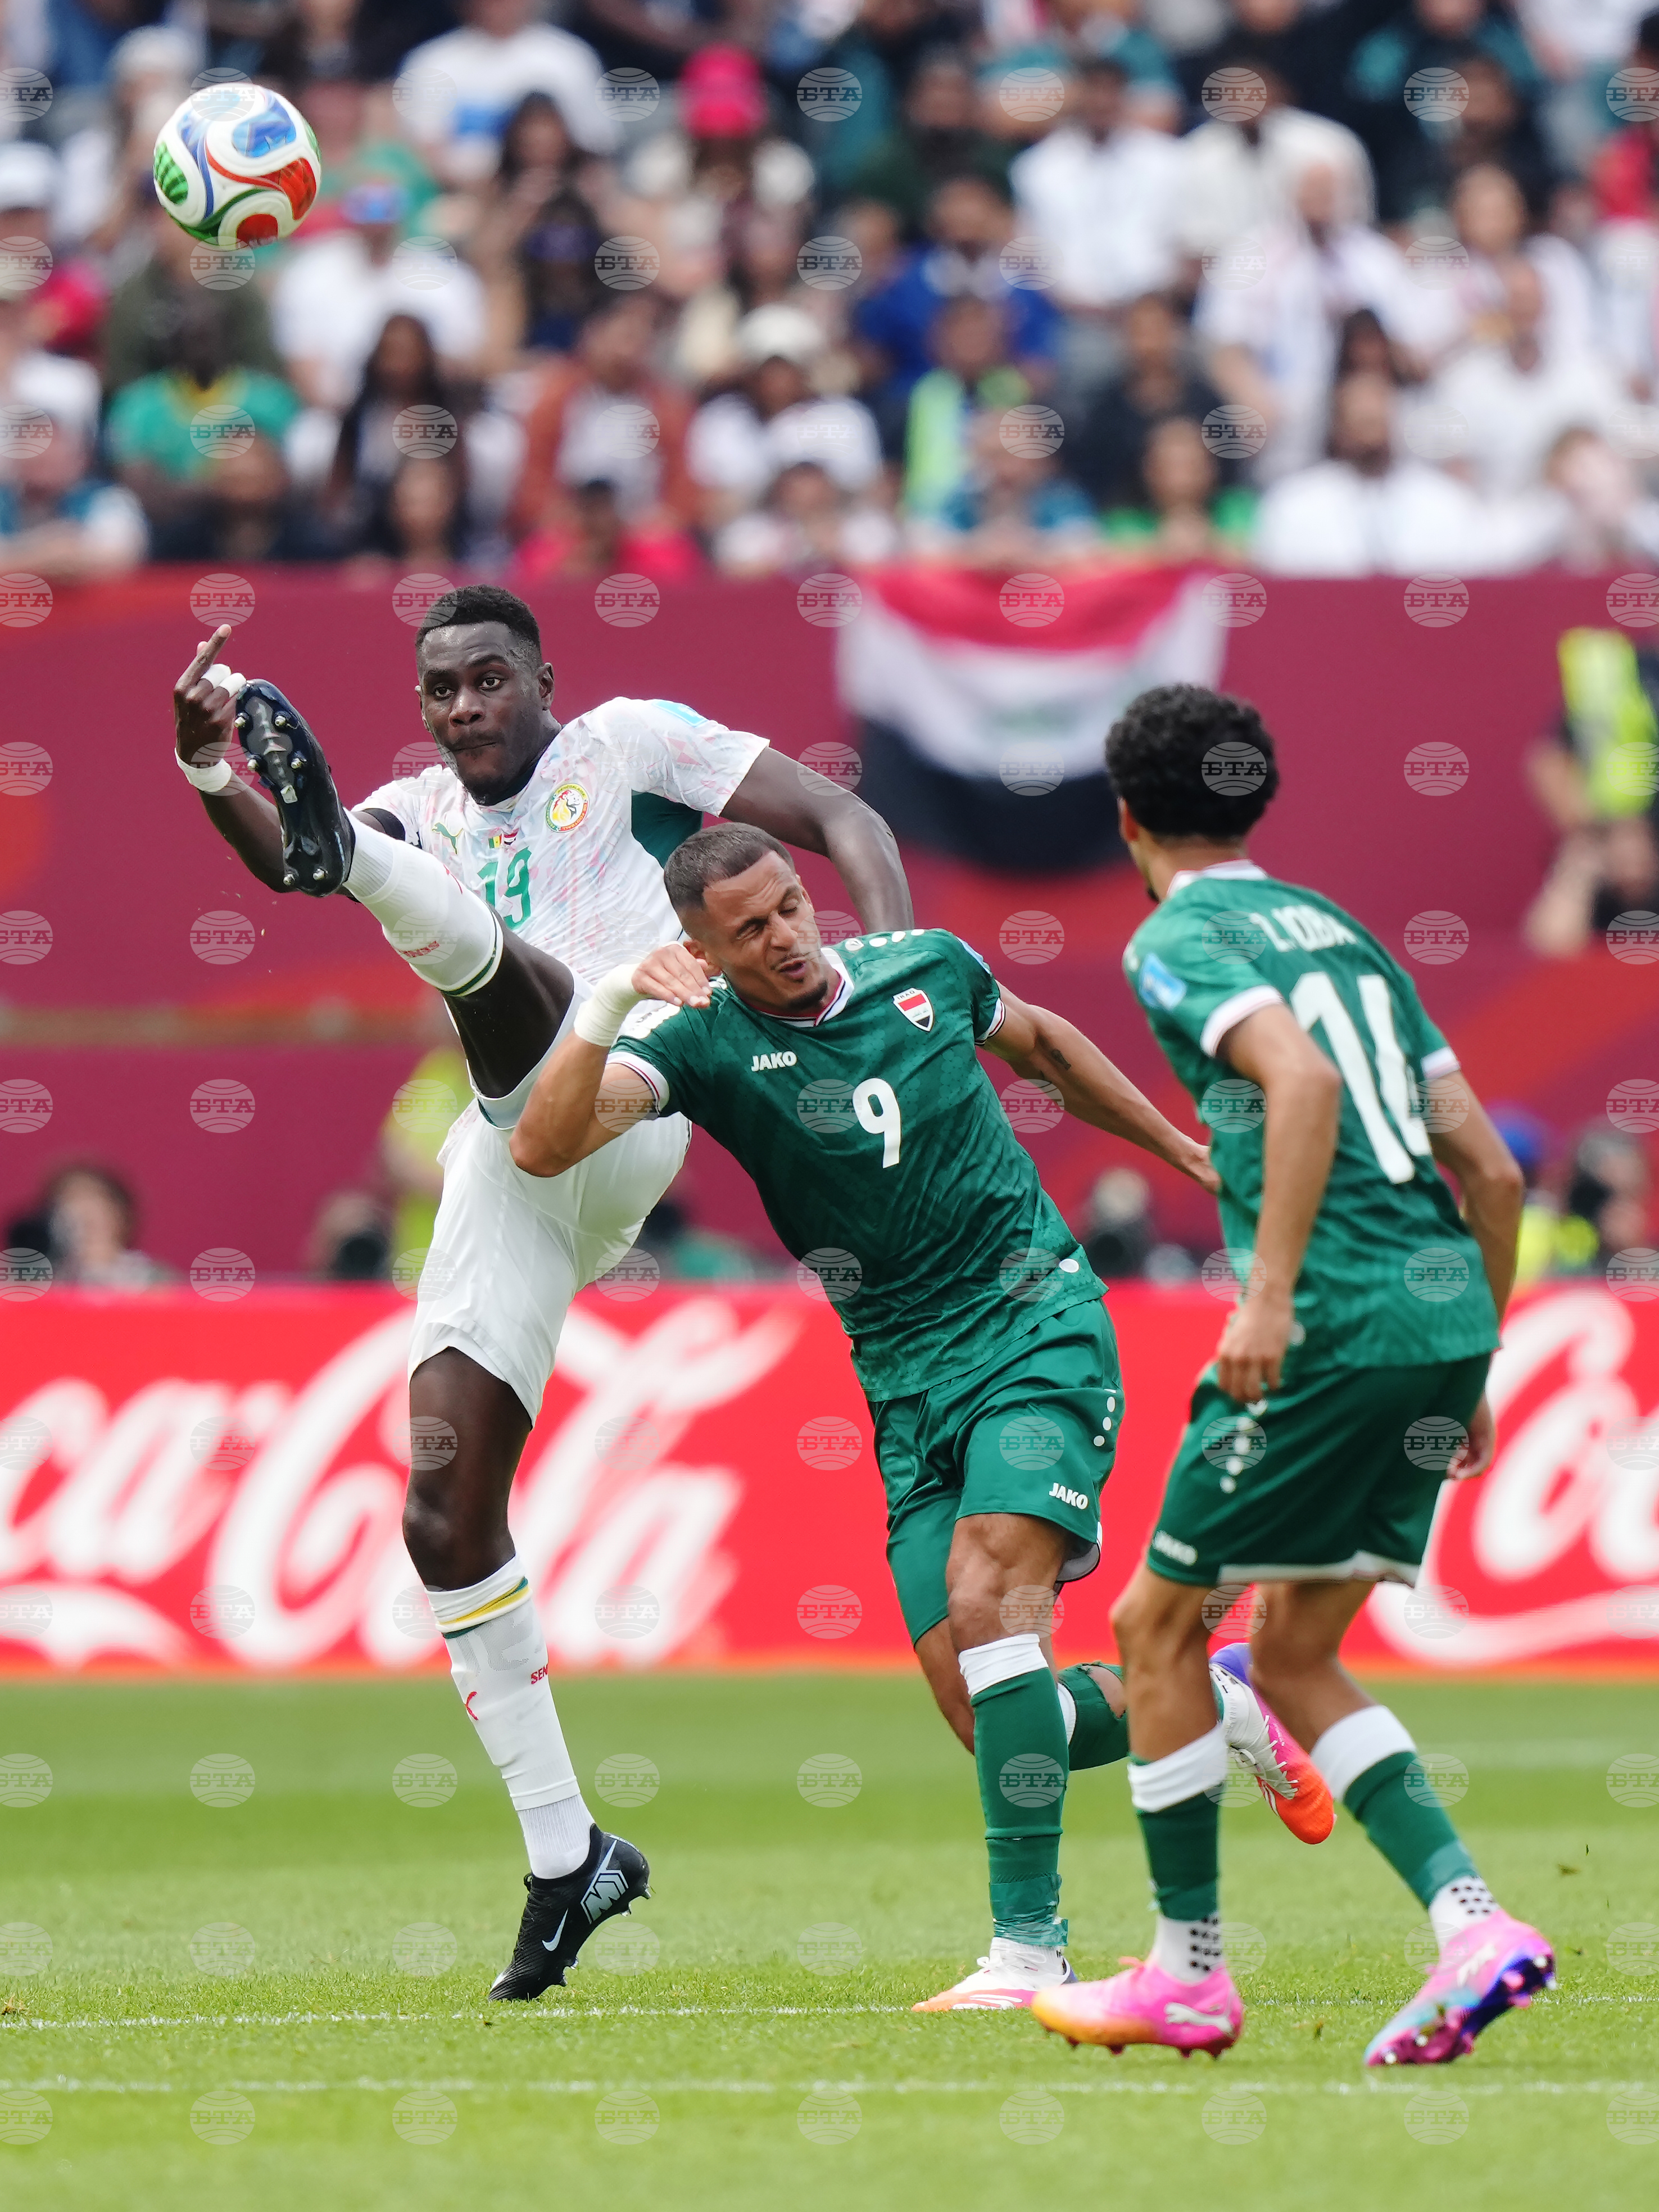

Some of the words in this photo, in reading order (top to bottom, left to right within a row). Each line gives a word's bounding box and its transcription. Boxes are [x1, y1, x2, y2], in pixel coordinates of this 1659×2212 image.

[477, 846, 532, 930] 19
[751, 1050, 797, 1072] JAKO
[852, 1077, 901, 1169] 9
[1049, 1482, 1089, 1510] JAKO
